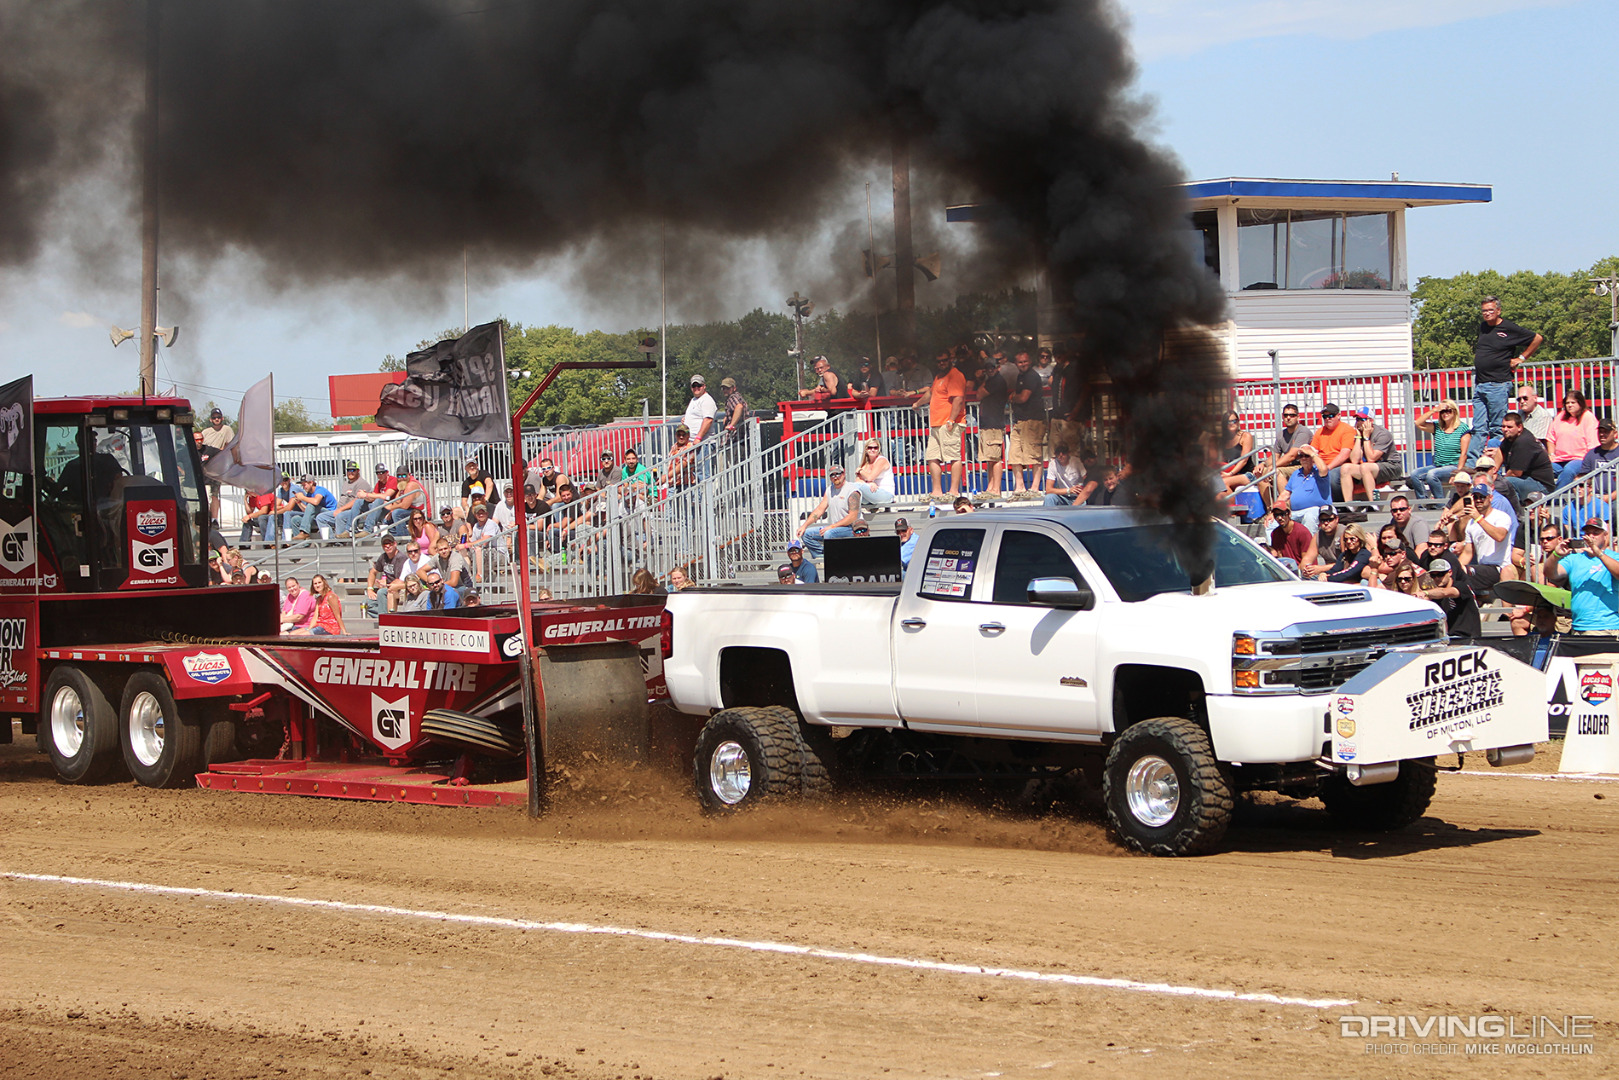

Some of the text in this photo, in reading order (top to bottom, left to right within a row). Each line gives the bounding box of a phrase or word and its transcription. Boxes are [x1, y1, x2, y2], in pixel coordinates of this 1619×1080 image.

[140, 517, 165, 525] LUCAS
[2, 532, 28, 562] GT
[138, 547, 169, 567] GT
[382, 629, 486, 649] GENERALTIRE.COM
[544, 615, 662, 639] GENERAL TIRE
[191, 660, 226, 672] LUCAS
[313, 656, 479, 693] GENERAL TIRE
[1424, 648, 1488, 688] ROCK
[1583, 676, 1600, 684] LUCAS
[1419, 677, 1493, 720] DIESEL
[376, 708, 405, 739] GT
[1426, 712, 1492, 740] OF MILTON, LLC
[1578, 714, 1610, 735] LEADER
